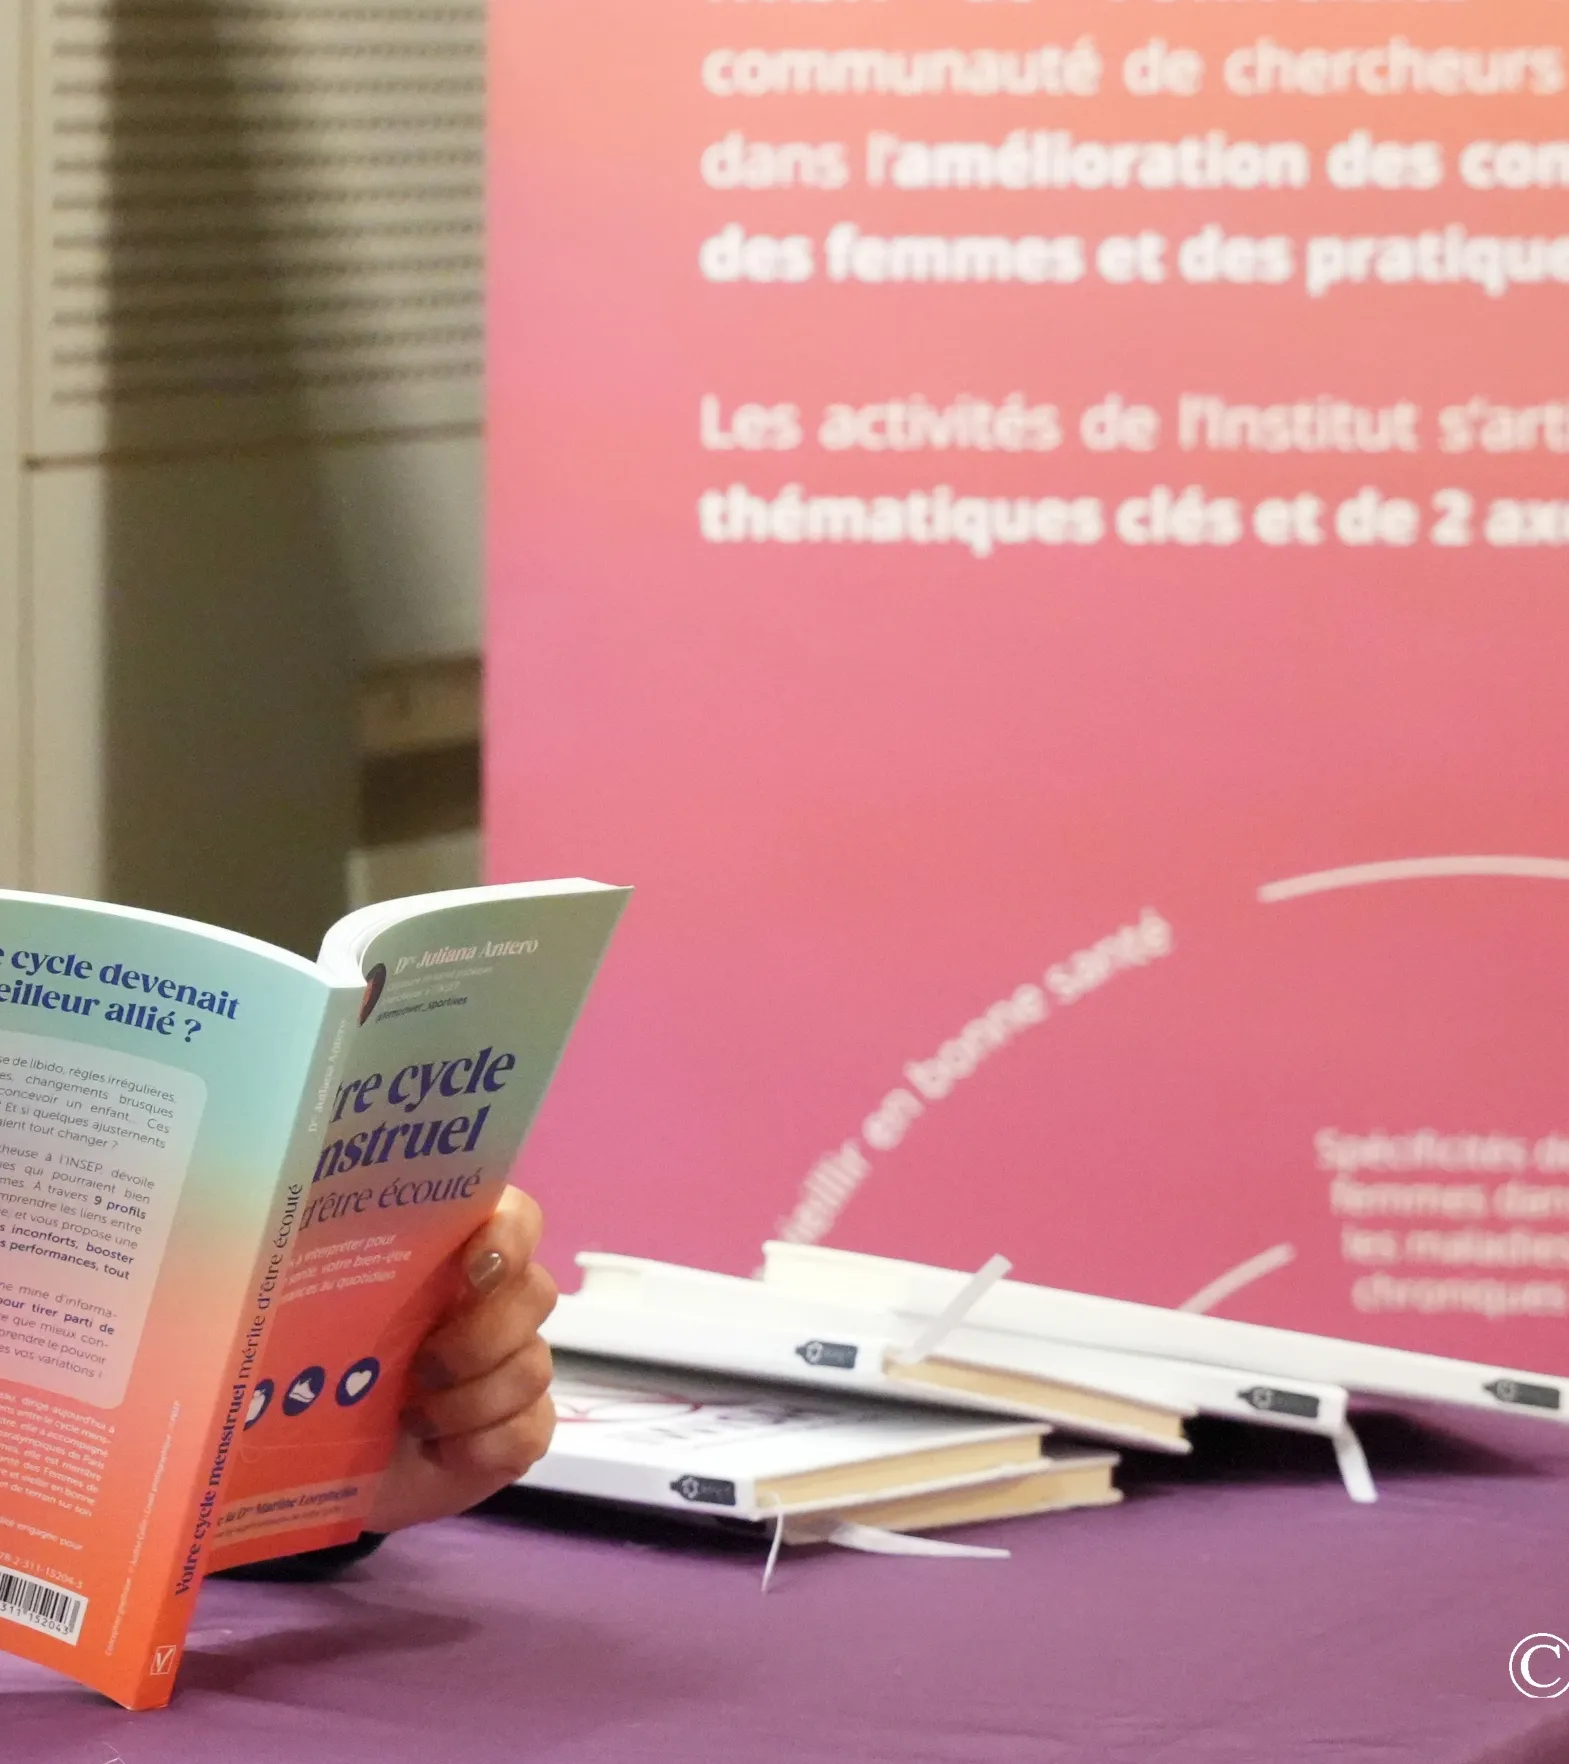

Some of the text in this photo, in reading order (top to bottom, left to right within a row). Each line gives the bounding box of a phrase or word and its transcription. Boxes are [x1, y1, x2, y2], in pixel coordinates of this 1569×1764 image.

[701, 38, 1564, 96] communauté de chercheurs
[701, 132, 849, 189] dans
[866, 130, 1310, 190] l'amélioration
[1325, 130, 1444, 190] des
[698, 222, 815, 284] des
[824, 221, 1087, 284] femmes
[1095, 231, 1167, 284] et
[1177, 223, 1295, 284] des
[700, 394, 803, 451] Les
[818, 393, 1063, 452] activités
[1079, 393, 1160, 452] de
[1178, 394, 1419, 453] l'Institut
[697, 483, 1106, 559] thématiques
[1114, 485, 1244, 546] clés
[1252, 491, 1325, 546] et
[1334, 486, 1421, 547] de
[1429, 487, 1474, 547] 2
[415, 945, 477, 969] Juliana
[478, 939, 539, 959] Antero
[10, 950, 92, 979] cycle
[99, 963, 241, 1020] devenait
[104, 1002, 175, 1036] allié
[183, 1018, 201, 1041] ?
[862, 1088, 924, 1151] en
[903, 983, 1049, 1100] bonne
[1044, 904, 1176, 1005] santé
[11, 1056, 28, 1067] de
[68, 1067, 105, 1083] règles
[387, 1045, 517, 1114] cycle
[25, 1075, 108, 1099] changements
[118, 1093, 173, 1118] brusques
[65, 1099, 82, 1109] un
[146, 1117, 169, 1134] Ces
[4, 1101, 17, 1113] Et
[20, 1106, 29, 1115] si
[32, 1108, 88, 1127] quelques
[91, 1121, 165, 1148] ajustements
[28, 1122, 55, 1135] tout
[57, 1128, 108, 1147] changer
[44, 1152, 52, 1162] à
[110, 1168, 154, 1189] dévoile
[59, 1202, 76, 1215] les
[79, 1207, 107, 1224] liens
[109, 1219, 142, 1234] entre
[297, 1166, 483, 1232] d'être écouté
[8, 1241, 99, 1271] performances,
[103, 1263, 130, 1280] tout
[11, 1224, 79, 1249] inconforts,
[85, 1241, 134, 1264] booster
[175, 1182, 304, 1598] Votre cycle menstruel mérite d'être écouté
